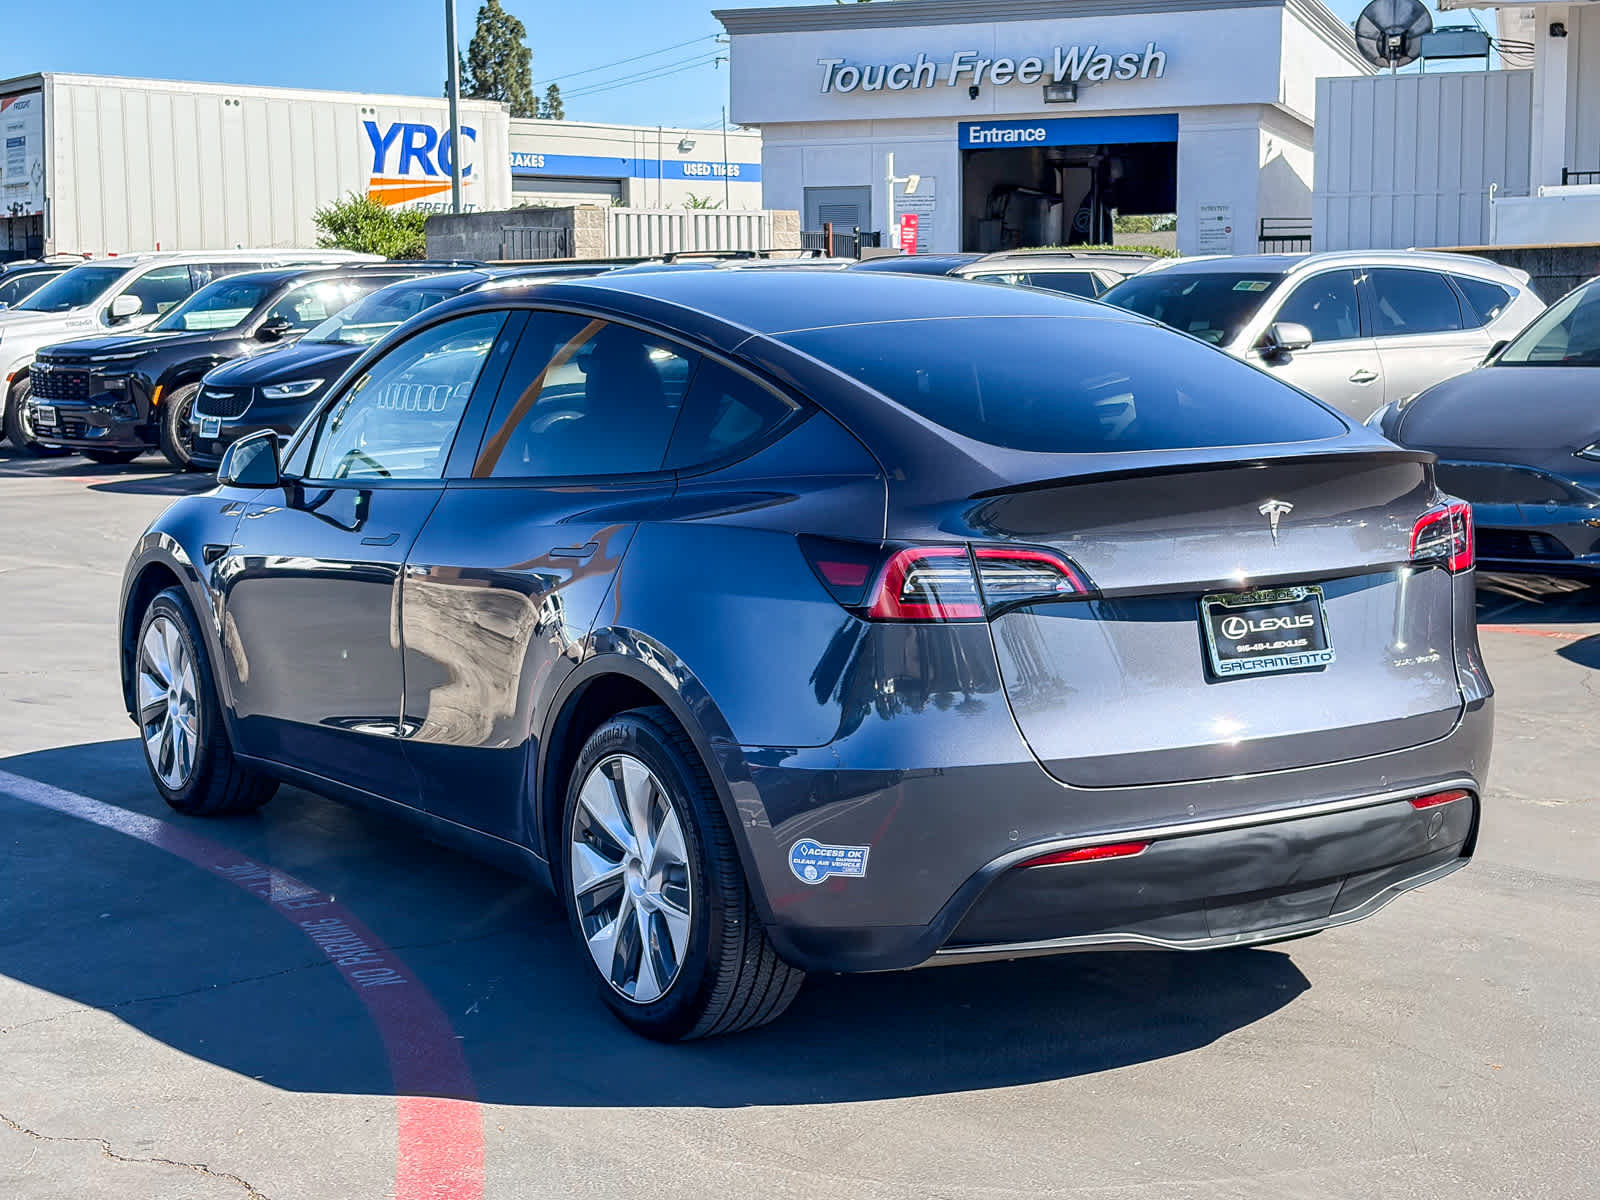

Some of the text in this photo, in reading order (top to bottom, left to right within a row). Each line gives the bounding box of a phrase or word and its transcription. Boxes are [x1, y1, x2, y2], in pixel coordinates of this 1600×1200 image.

[816, 41, 1168, 94] Touch Free Wash
[968, 126, 1047, 144] Entrance
[362, 120, 477, 178] YRC
[683, 162, 741, 177] USED TIRES
[1249, 614, 1314, 632] LEXUS
[1220, 653, 1332, 673] SACRAMENTO
[808, 848, 863, 858] ACCESS OK
[817, 859, 831, 867] AIR
[351, 967, 409, 988] NO
